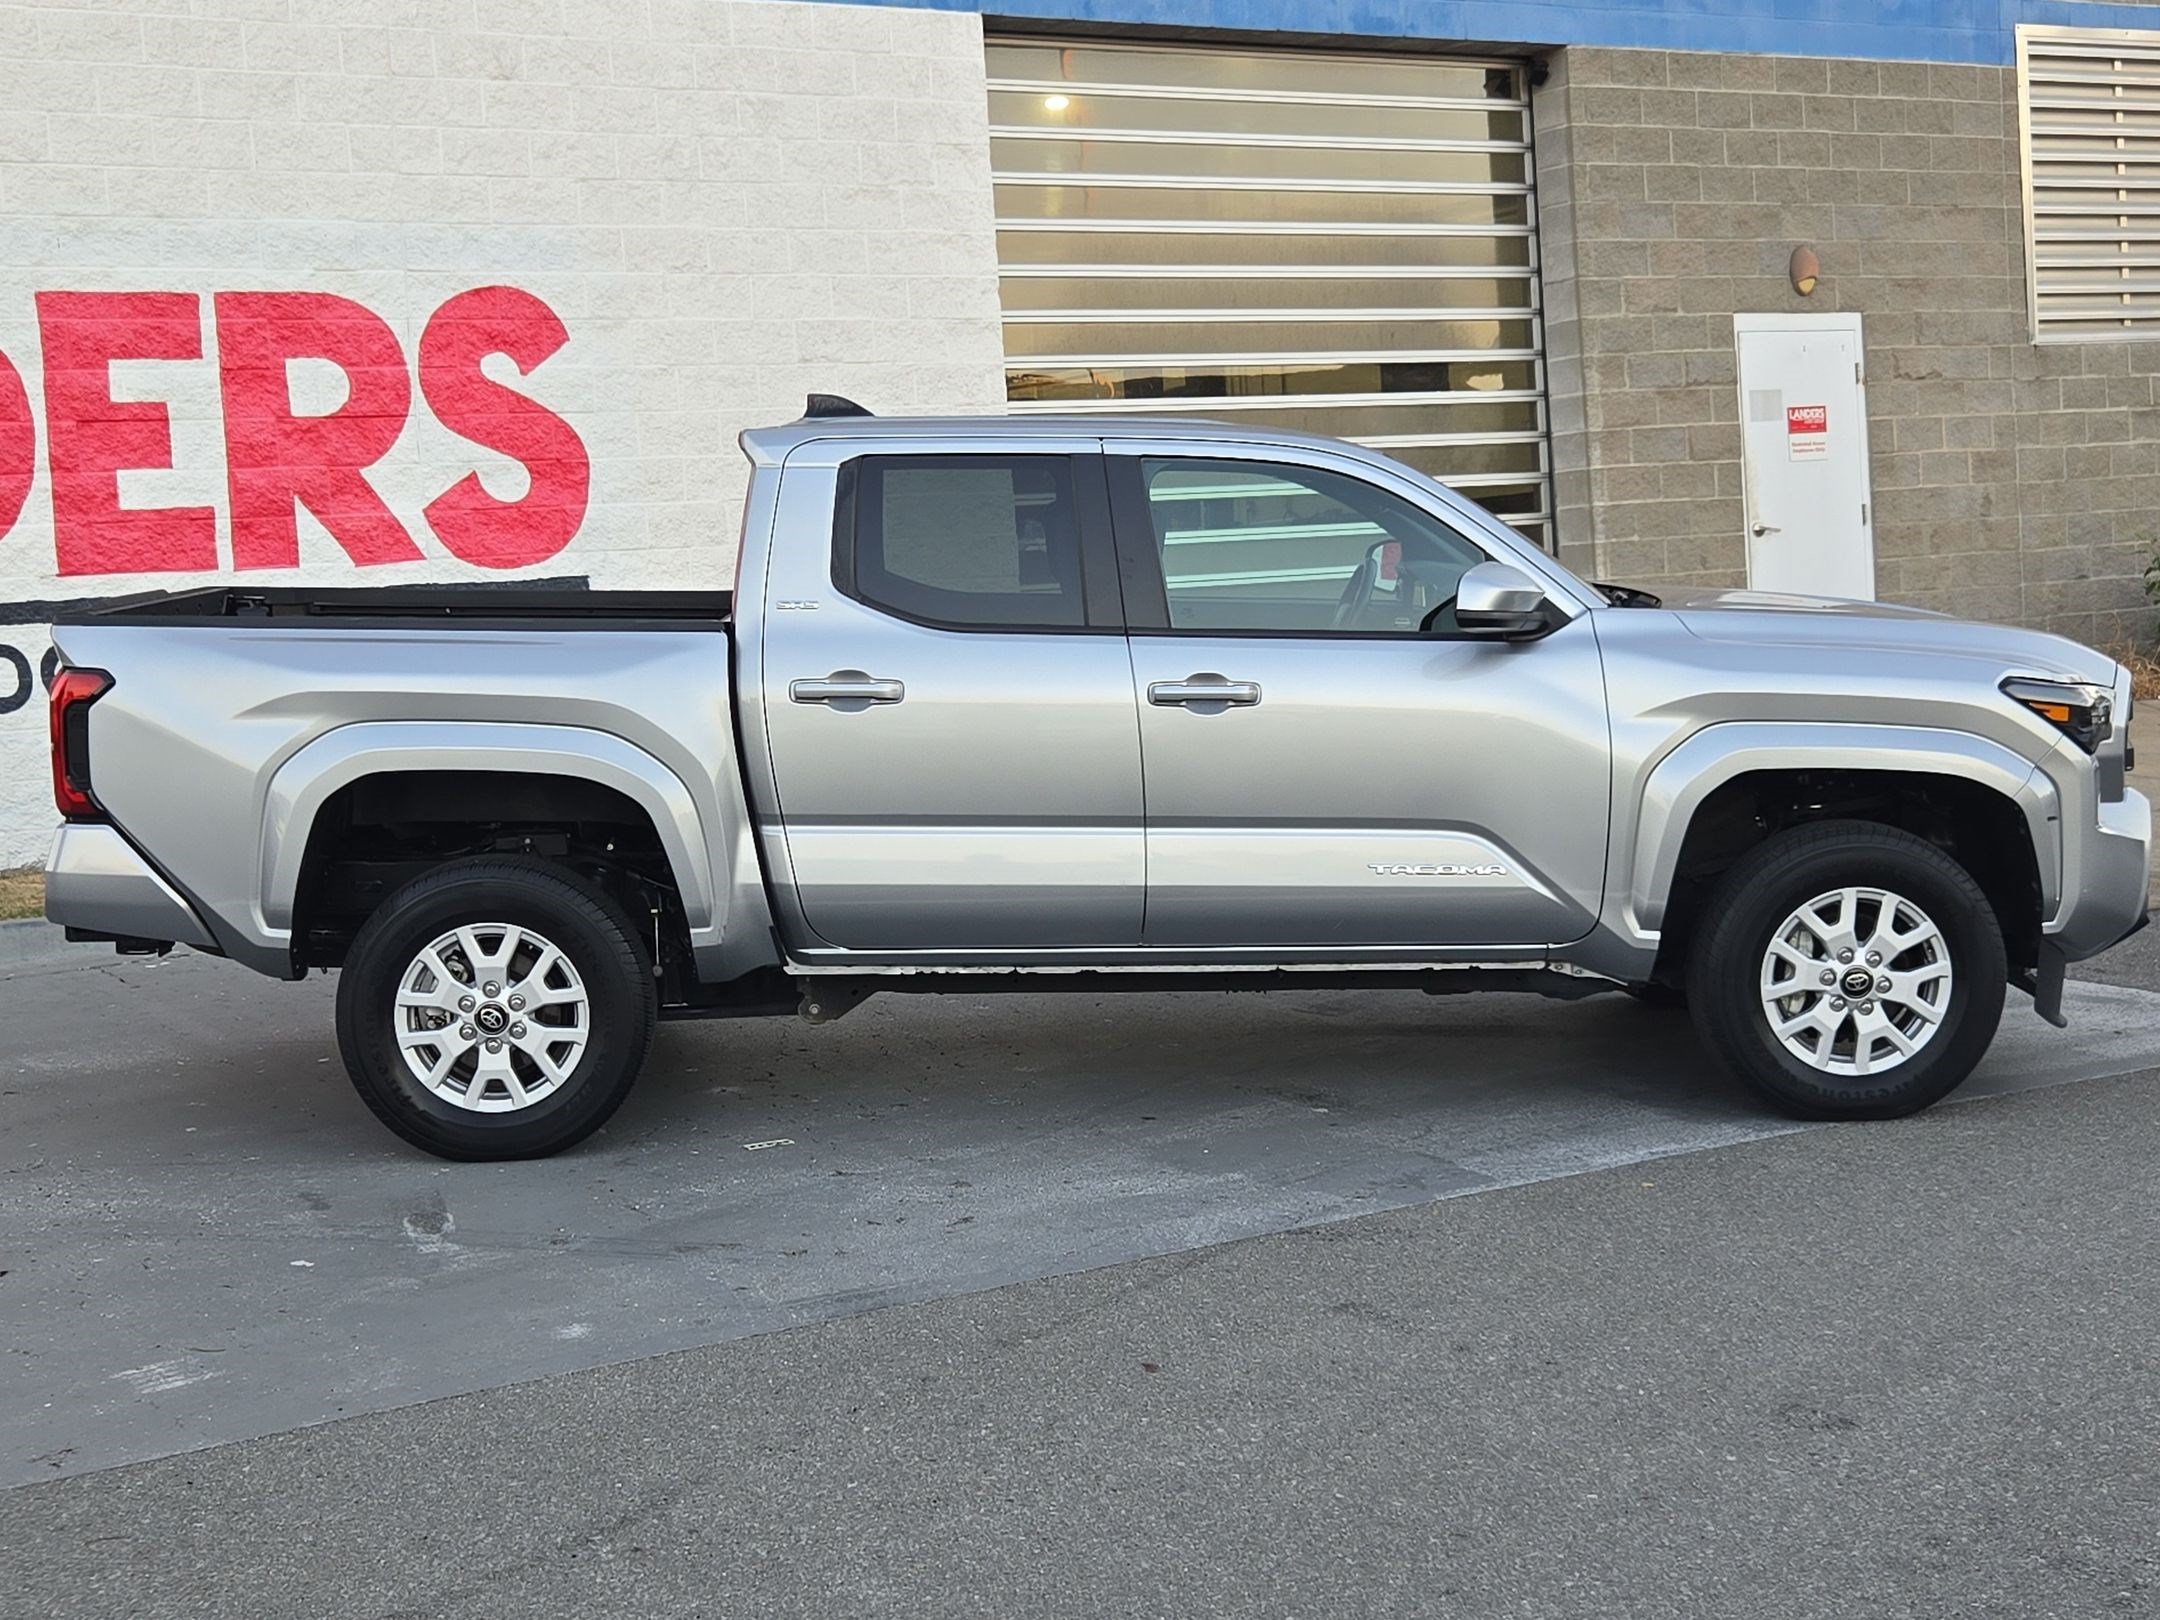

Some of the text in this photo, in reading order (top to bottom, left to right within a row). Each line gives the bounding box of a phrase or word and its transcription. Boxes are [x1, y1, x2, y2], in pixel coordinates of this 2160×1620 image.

[1789, 408, 1824, 420] LANDERS
[0, 286, 590, 576] ERS
[1368, 864, 1507, 875] TACOMA
